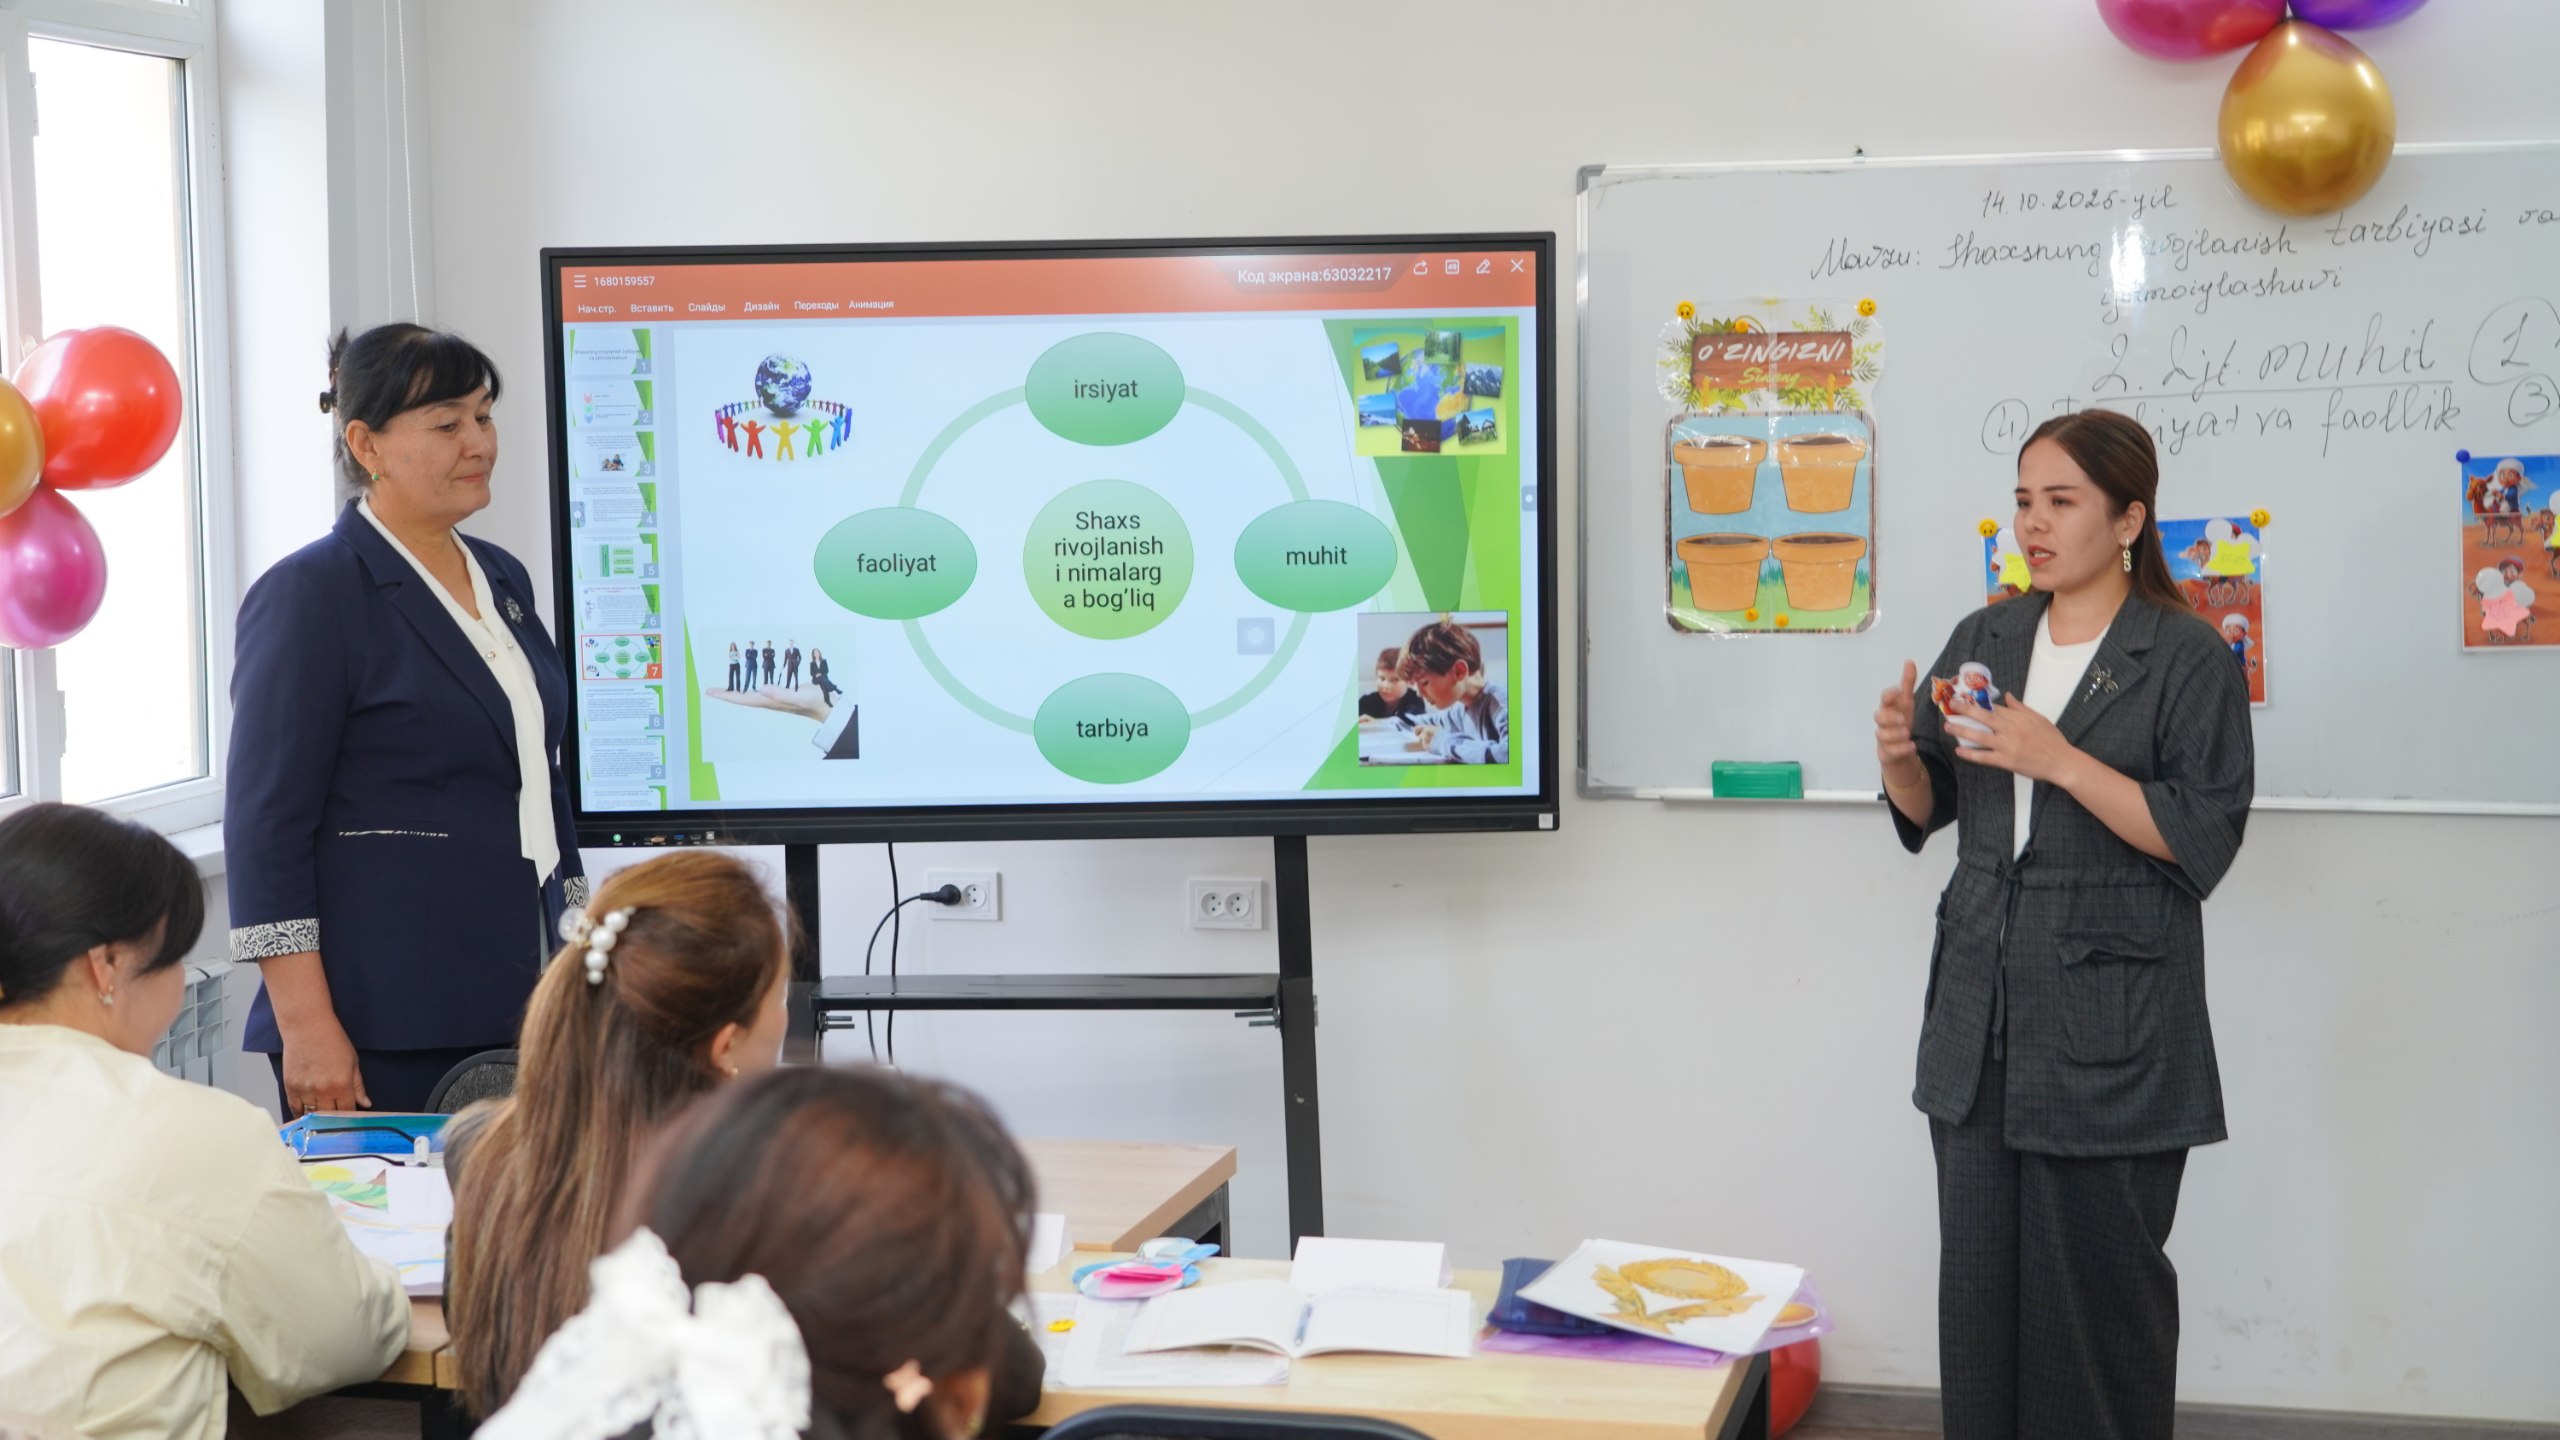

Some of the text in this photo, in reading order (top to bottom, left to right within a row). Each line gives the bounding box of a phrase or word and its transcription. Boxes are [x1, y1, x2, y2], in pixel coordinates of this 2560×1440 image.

[1938, 231, 2101, 277] Shaxsning
[2325, 205, 2488, 257] tarbiyasi
[2518, 208, 2560, 225] va
[594, 275, 656, 287] 1680159557
[1238, 266, 1392, 285] Код экрана:63032217
[578, 303, 617, 316] Нач.стр.
[630, 302, 674, 314] Вставить
[688, 301, 726, 314] Слайды
[744, 300, 780, 313] Дизайн
[794, 299, 840, 312] Переходы
[848, 298, 894, 311] Анимация
[1698, 338, 1847, 364] O'ZINGIZNI
[2259, 312, 2435, 382] muhit
[1074, 379, 1139, 403] irsiyat
[2256, 406, 2293, 437] va
[2321, 384, 2461, 457] faollik
[1075, 511, 1141, 530] Shaxs
[1054, 536, 1164, 561] rivojlanish
[1286, 545, 1348, 566] muhit
[856, 553, 937, 577] faoliyat
[1055, 562, 1162, 586] i nimalarg
[1063, 588, 1155, 612] a bog'liq
[1076, 718, 1149, 742] tarbiya
